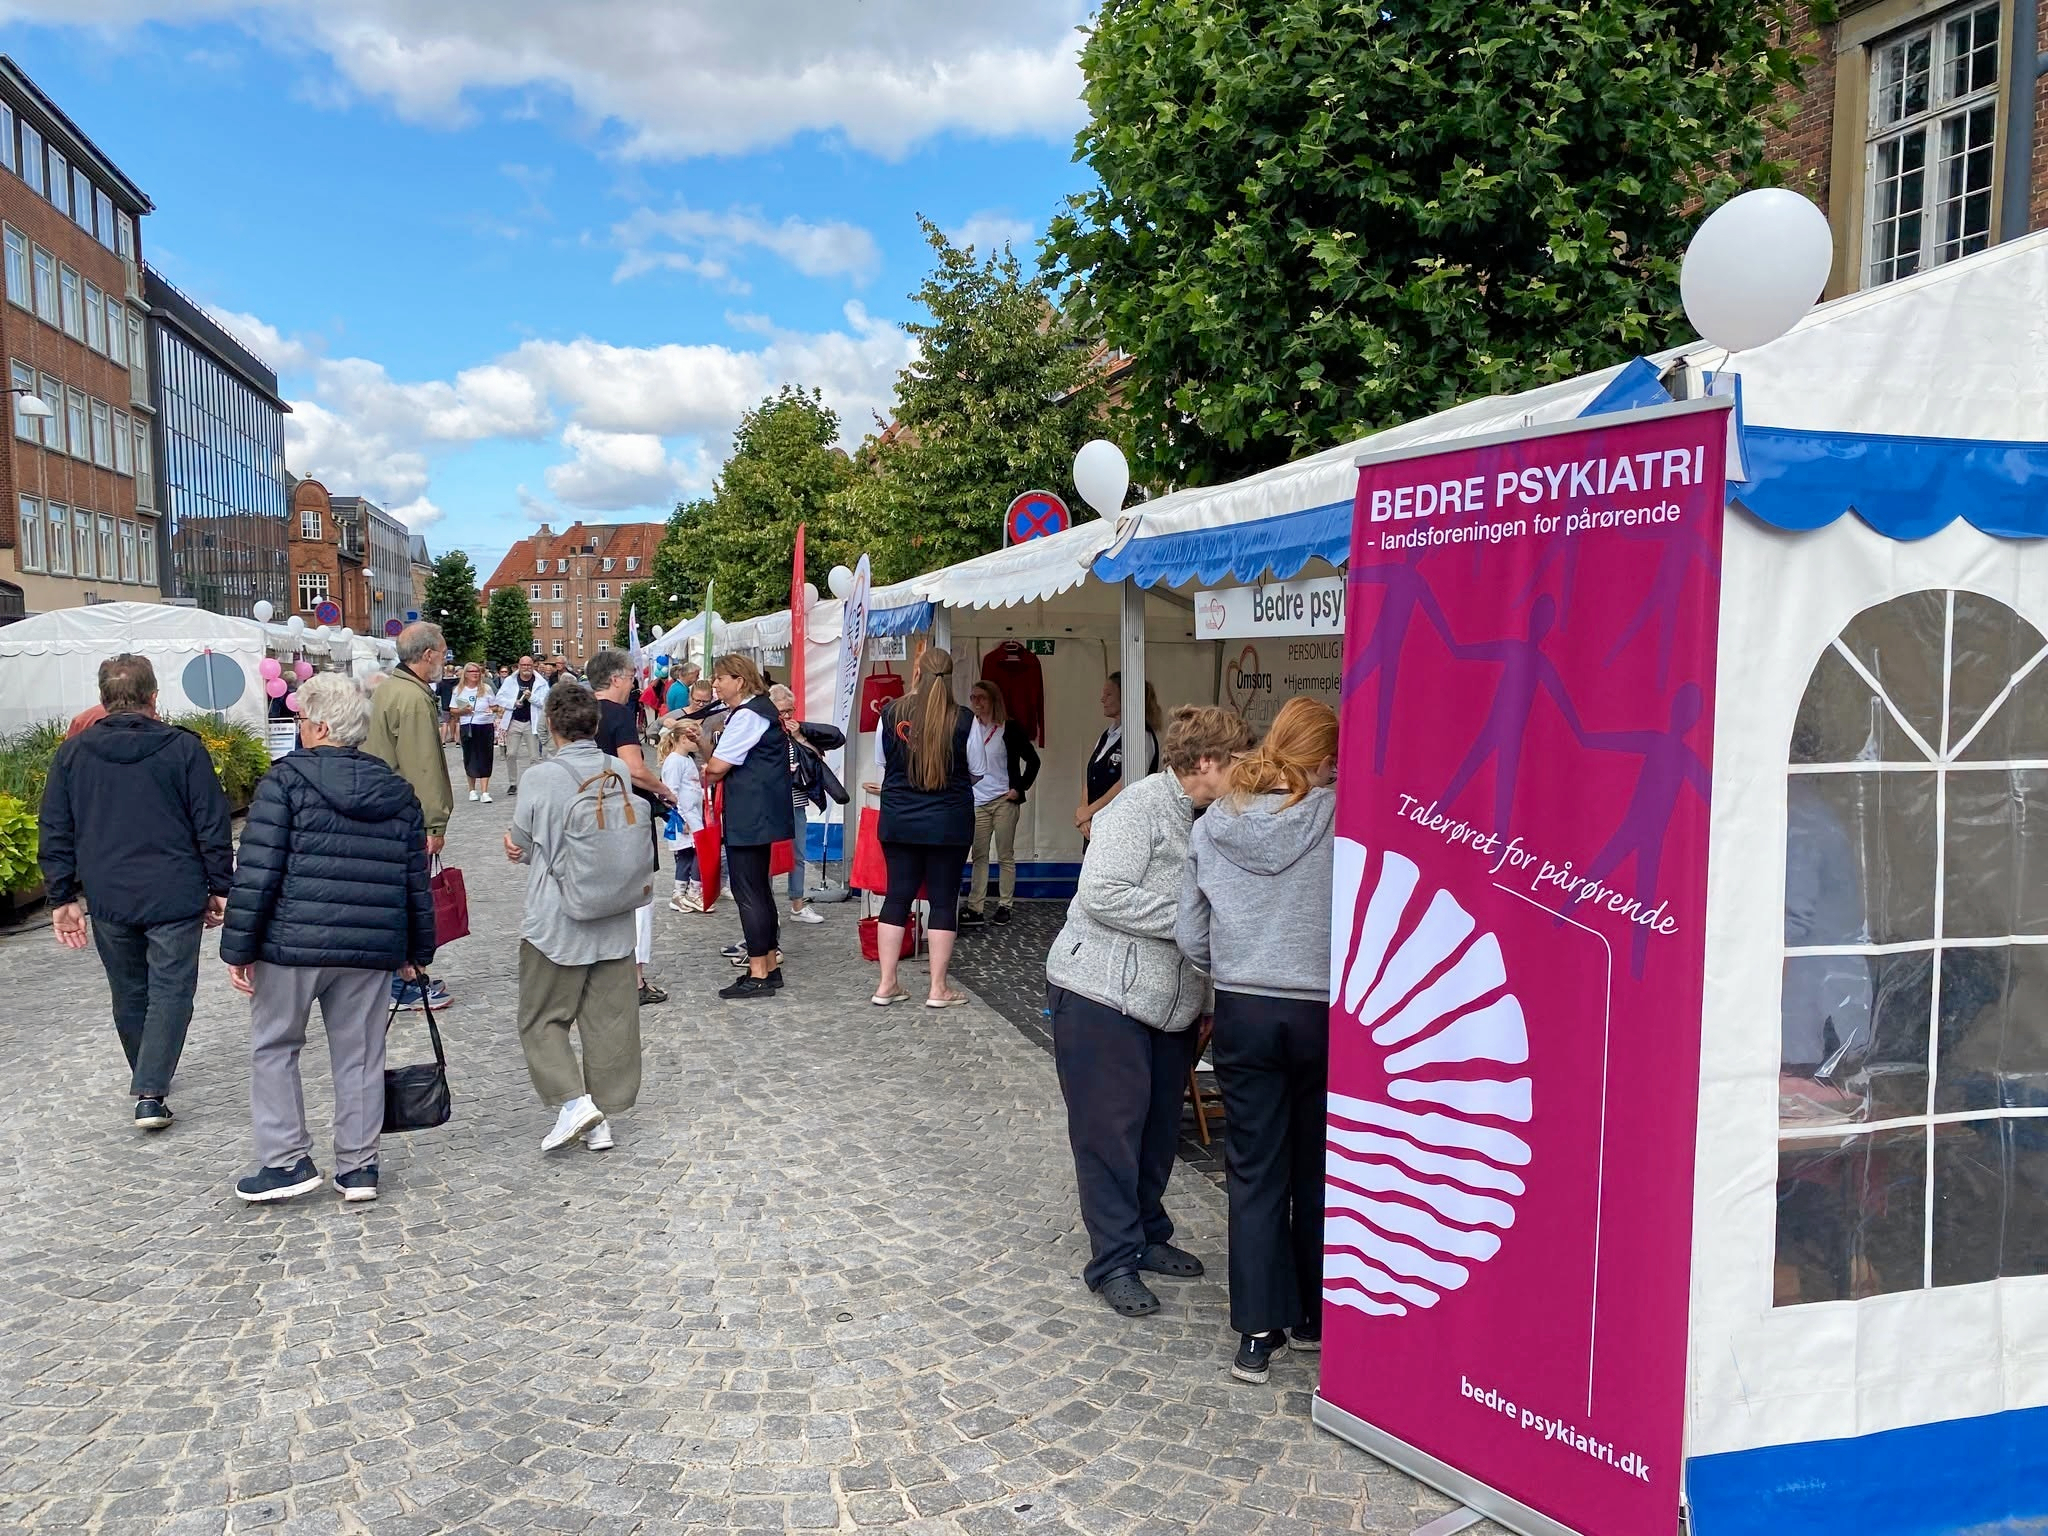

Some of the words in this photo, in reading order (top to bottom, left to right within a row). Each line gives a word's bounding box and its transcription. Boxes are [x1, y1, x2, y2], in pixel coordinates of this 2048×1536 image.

[1370, 477, 1485, 522] BEDRE
[1497, 446, 1705, 508] PSYKIATRI
[1381, 520, 1526, 550] landsforeningen
[1533, 513, 1561, 534] for
[1566, 500, 1681, 536] pårørende
[1253, 585, 1304, 623] Bedre
[1288, 641, 1339, 661] PERSONLIG
[1236, 669, 1272, 694] Omsorg
[1397, 793, 1502, 855] Talerøret
[1488, 836, 1538, 874] for
[1530, 861, 1679, 935] pårørende
[1461, 1375, 1517, 1419] bedre
[1521, 1408, 1650, 1483] psykiatri.dk
